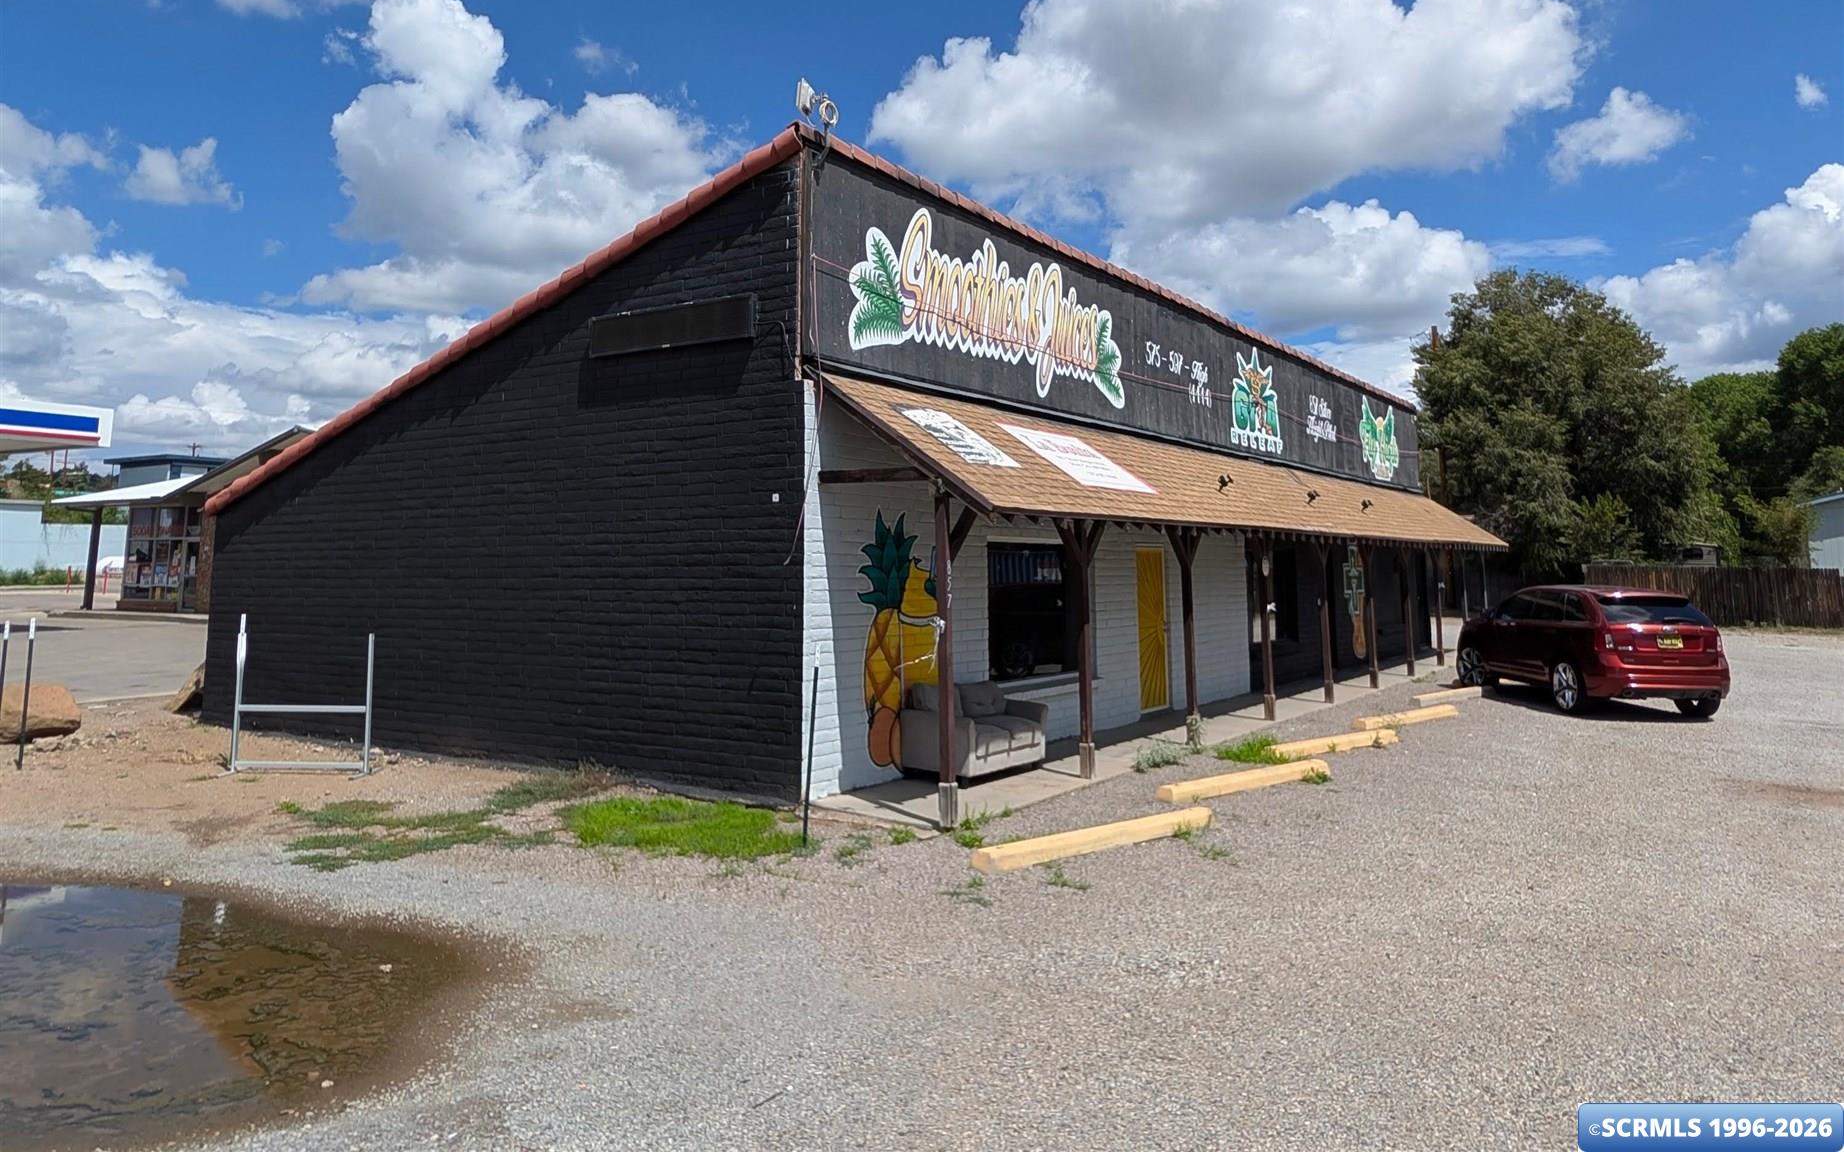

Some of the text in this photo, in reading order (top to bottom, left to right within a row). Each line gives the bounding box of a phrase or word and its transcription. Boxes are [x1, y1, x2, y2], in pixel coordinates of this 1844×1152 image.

[901, 211, 1099, 393] Smoothies & Juices
[1231, 427, 1284, 454] RELEAF
